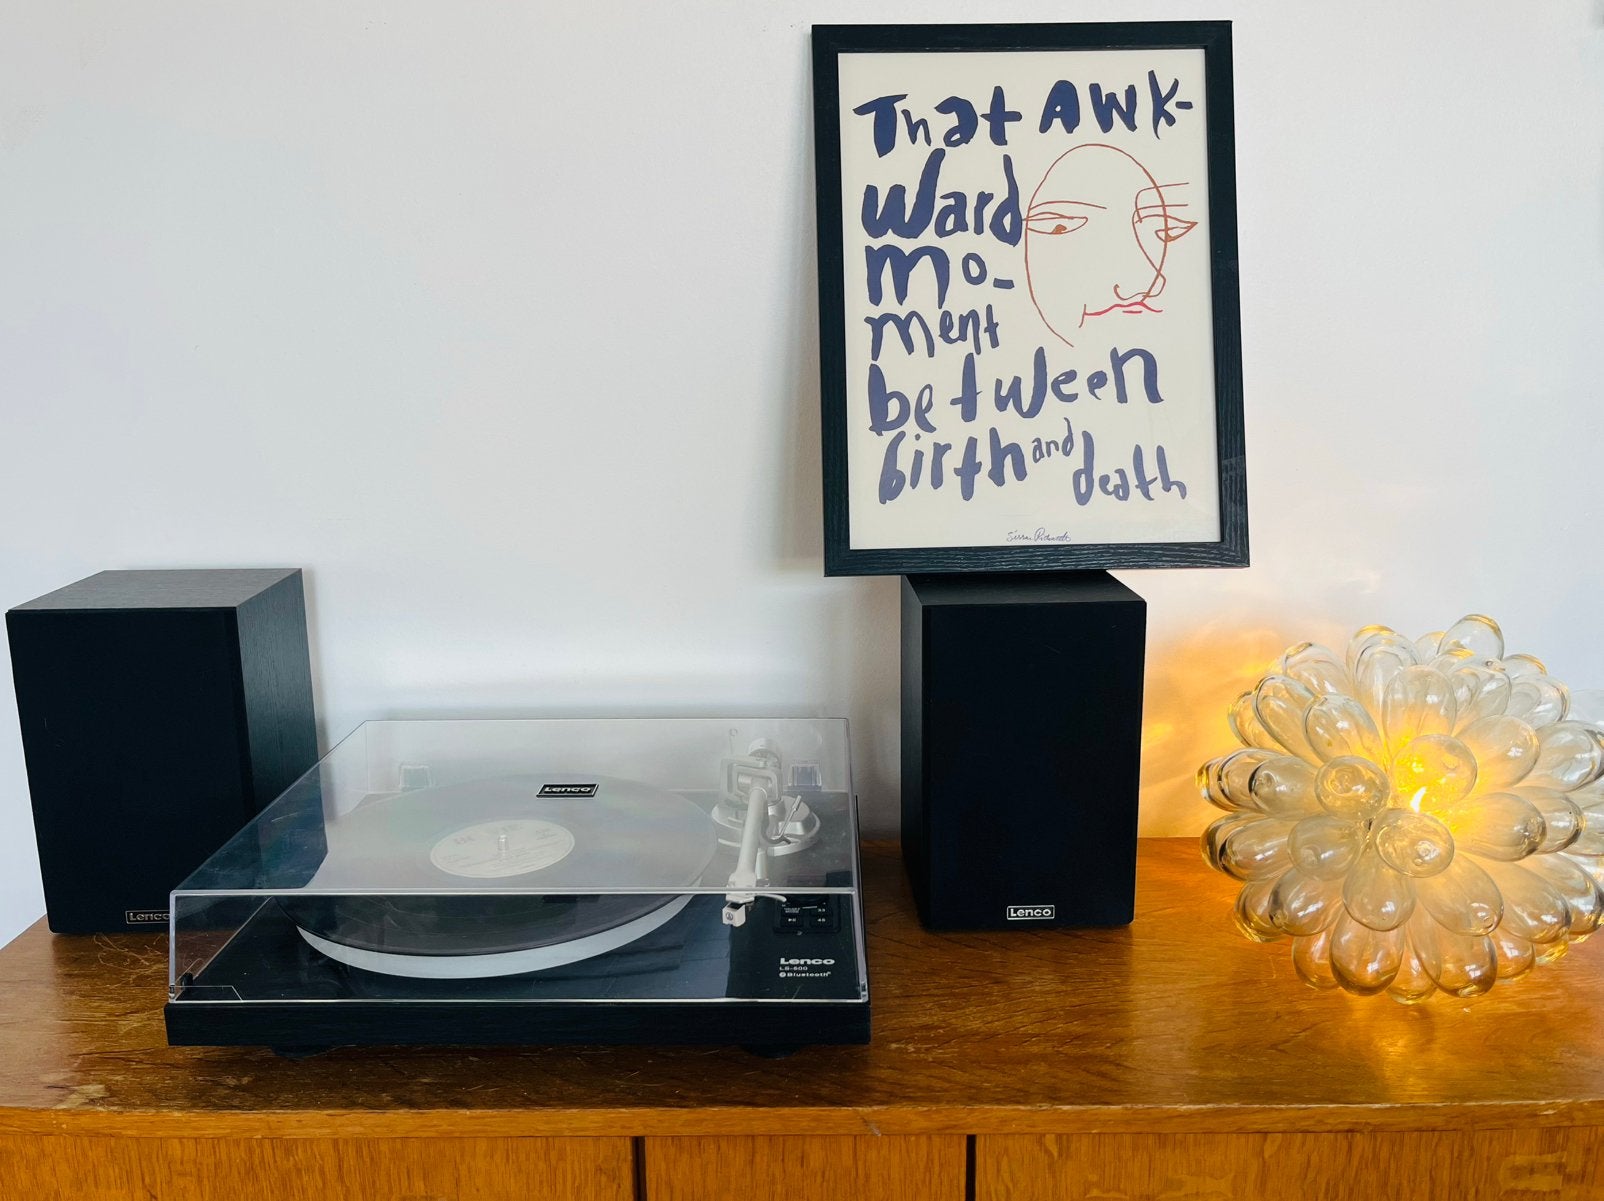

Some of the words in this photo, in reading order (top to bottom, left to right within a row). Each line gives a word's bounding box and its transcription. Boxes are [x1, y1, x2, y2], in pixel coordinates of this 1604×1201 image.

[852, 85, 1023, 158] That
[1038, 69, 1194, 140] AWK-
[864, 303, 1000, 361] ment
[867, 346, 1164, 436] between
[878, 426, 1028, 504] birth
[1031, 417, 1074, 464] and
[1072, 430, 1188, 506] death
[1010, 908, 1052, 917] Lenco
[780, 957, 835, 965] Lenco
